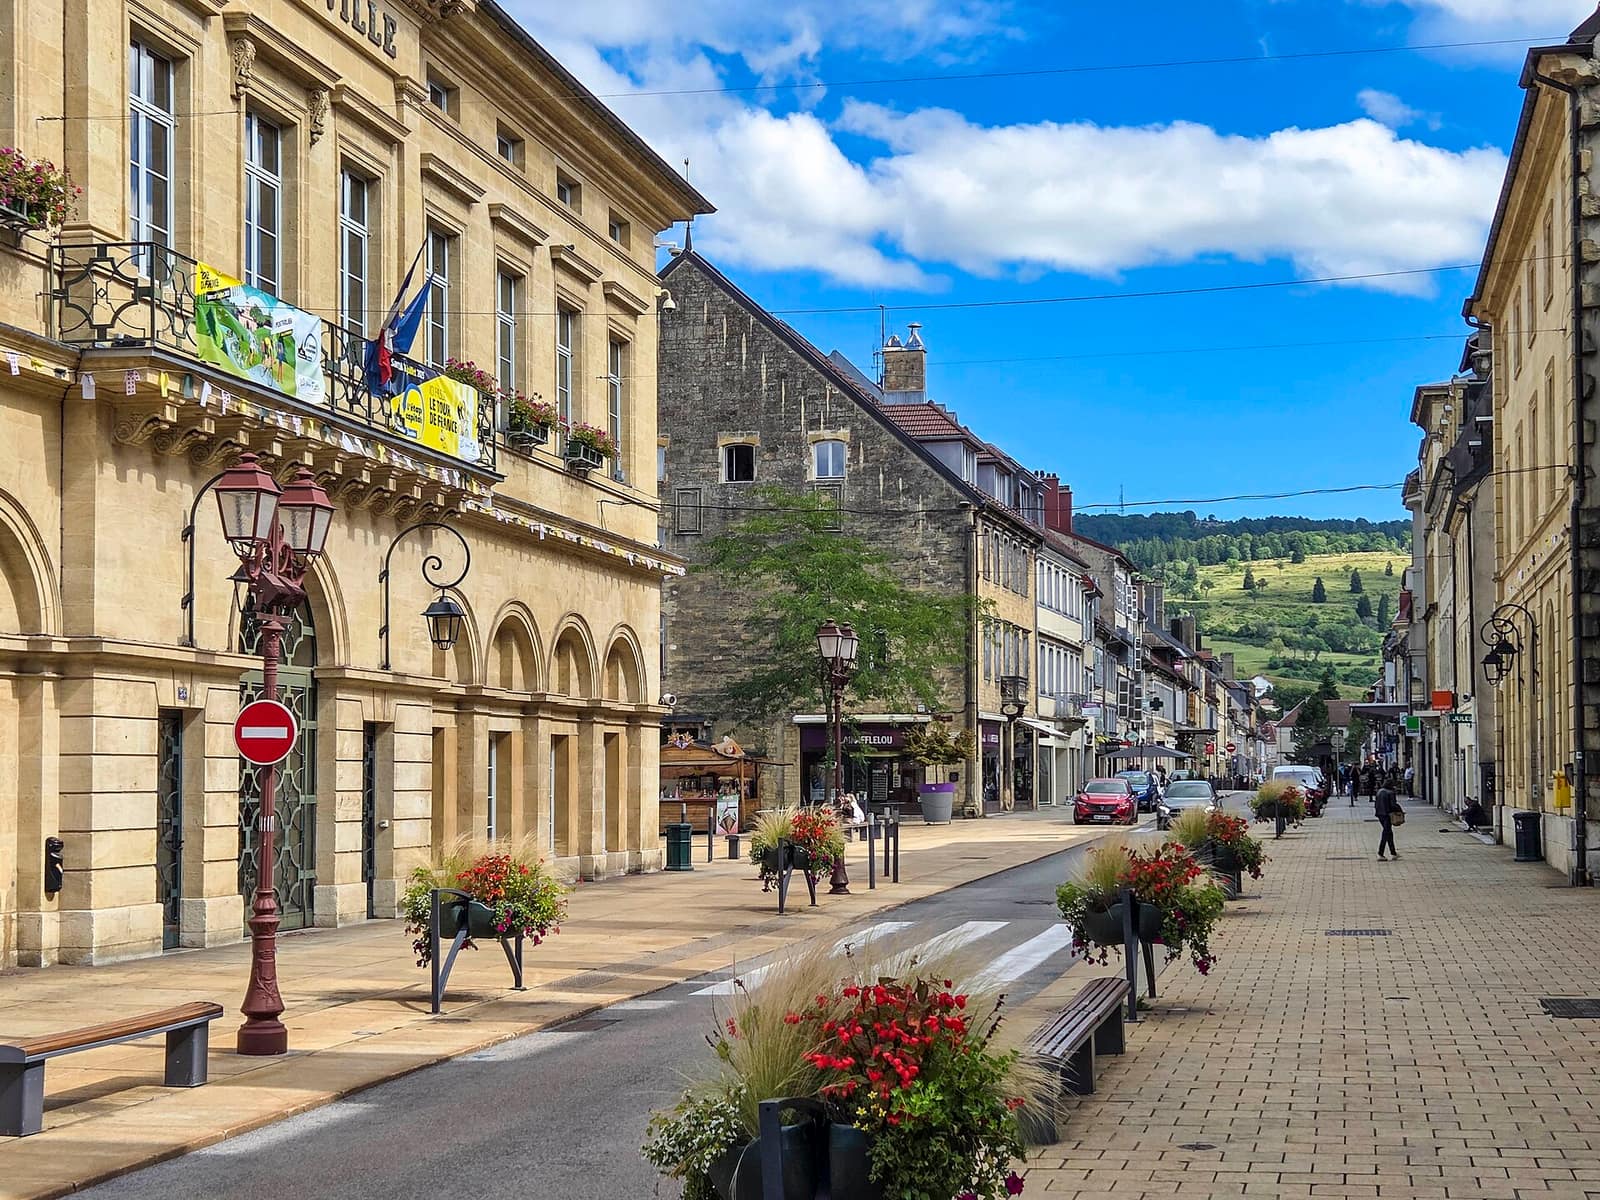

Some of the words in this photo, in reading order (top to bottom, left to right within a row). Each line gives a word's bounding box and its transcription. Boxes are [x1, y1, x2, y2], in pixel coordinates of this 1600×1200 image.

[326, 0, 396, 59] ILLE
[429, 397, 436, 412] LE
[437, 400, 451, 418] TOUR
[429, 412, 437, 426] DE
[437, 414, 457, 434] FRANCE
